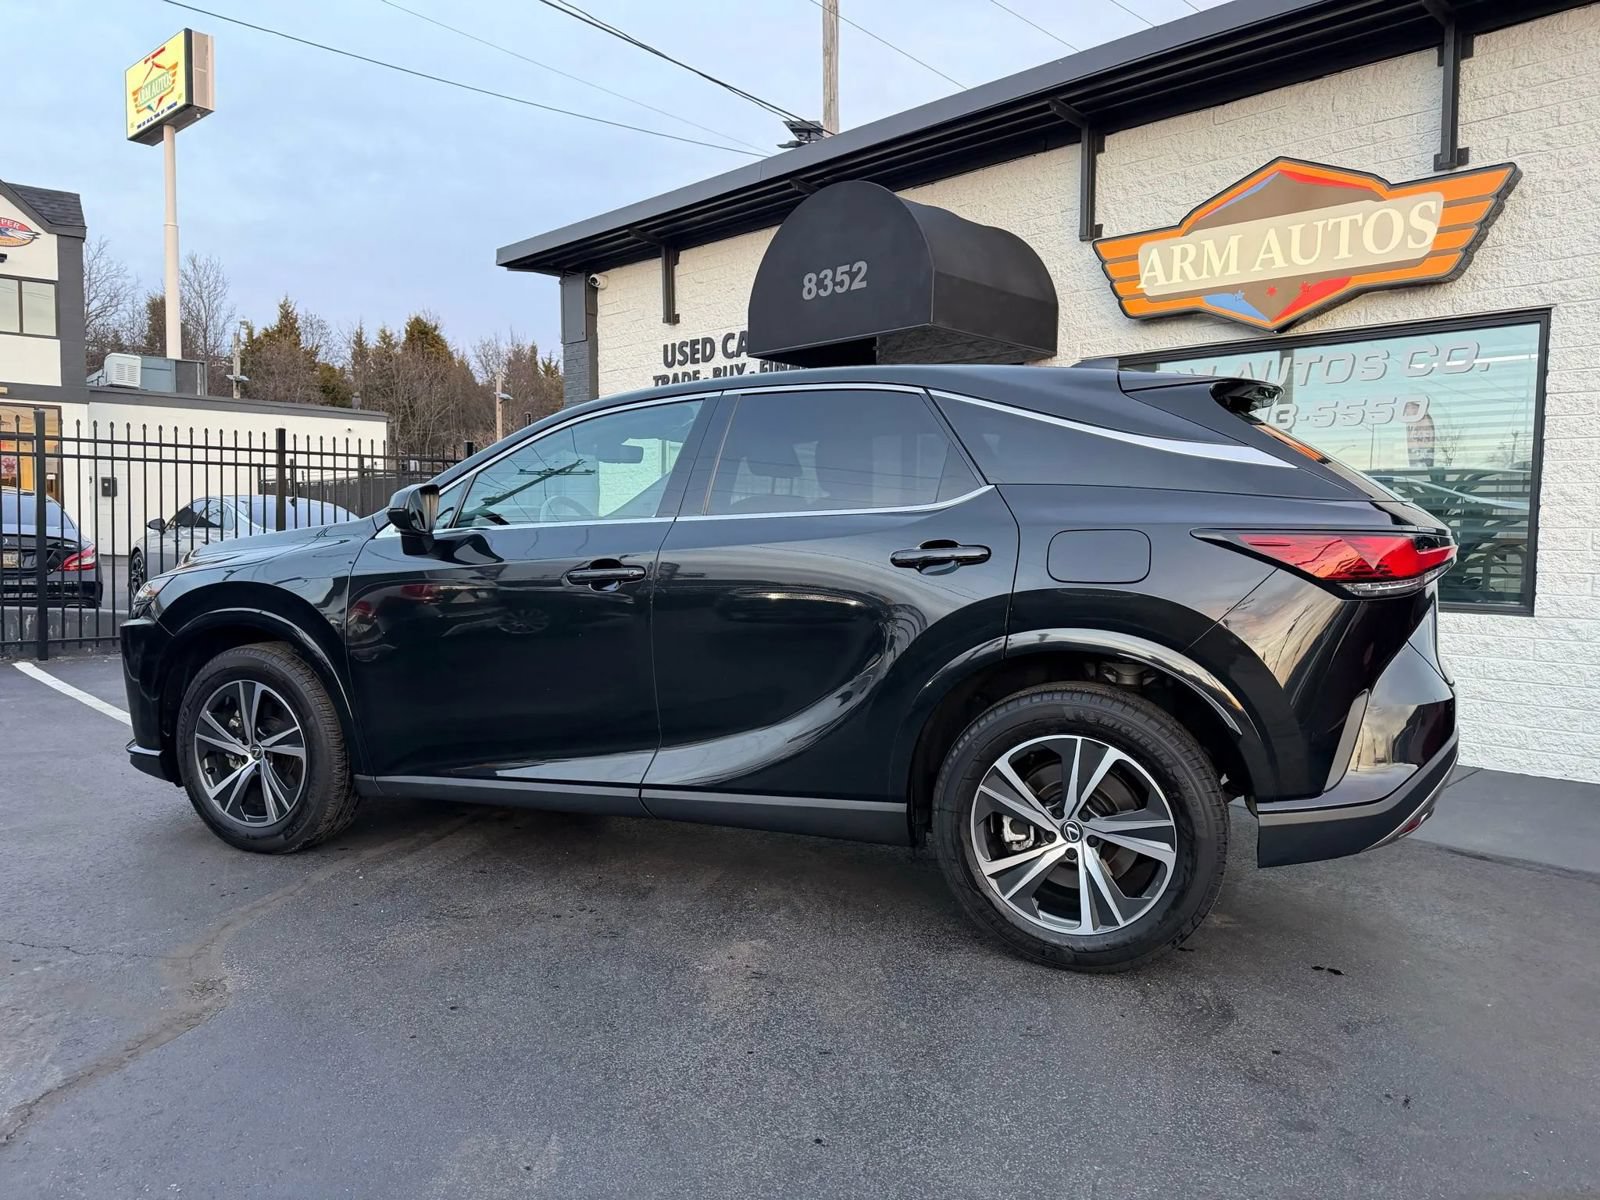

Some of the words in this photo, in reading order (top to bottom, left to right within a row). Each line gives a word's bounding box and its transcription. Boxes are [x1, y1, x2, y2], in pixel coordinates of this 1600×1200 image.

[0, 219, 20, 230] PER
[1137, 234, 1240, 289] ARM
[1251, 200, 1438, 271] AUTOS
[802, 260, 868, 300] 8352
[663, 337, 715, 368] USED
[722, 330, 749, 359] CA
[1404, 340, 1490, 378] CO.
[653, 370, 700, 387] TRADE
[713, 363, 747, 378] BUY
[1259, 395, 1430, 430] 3-5550
[1099, 714, 1173, 768] MICHELIN
